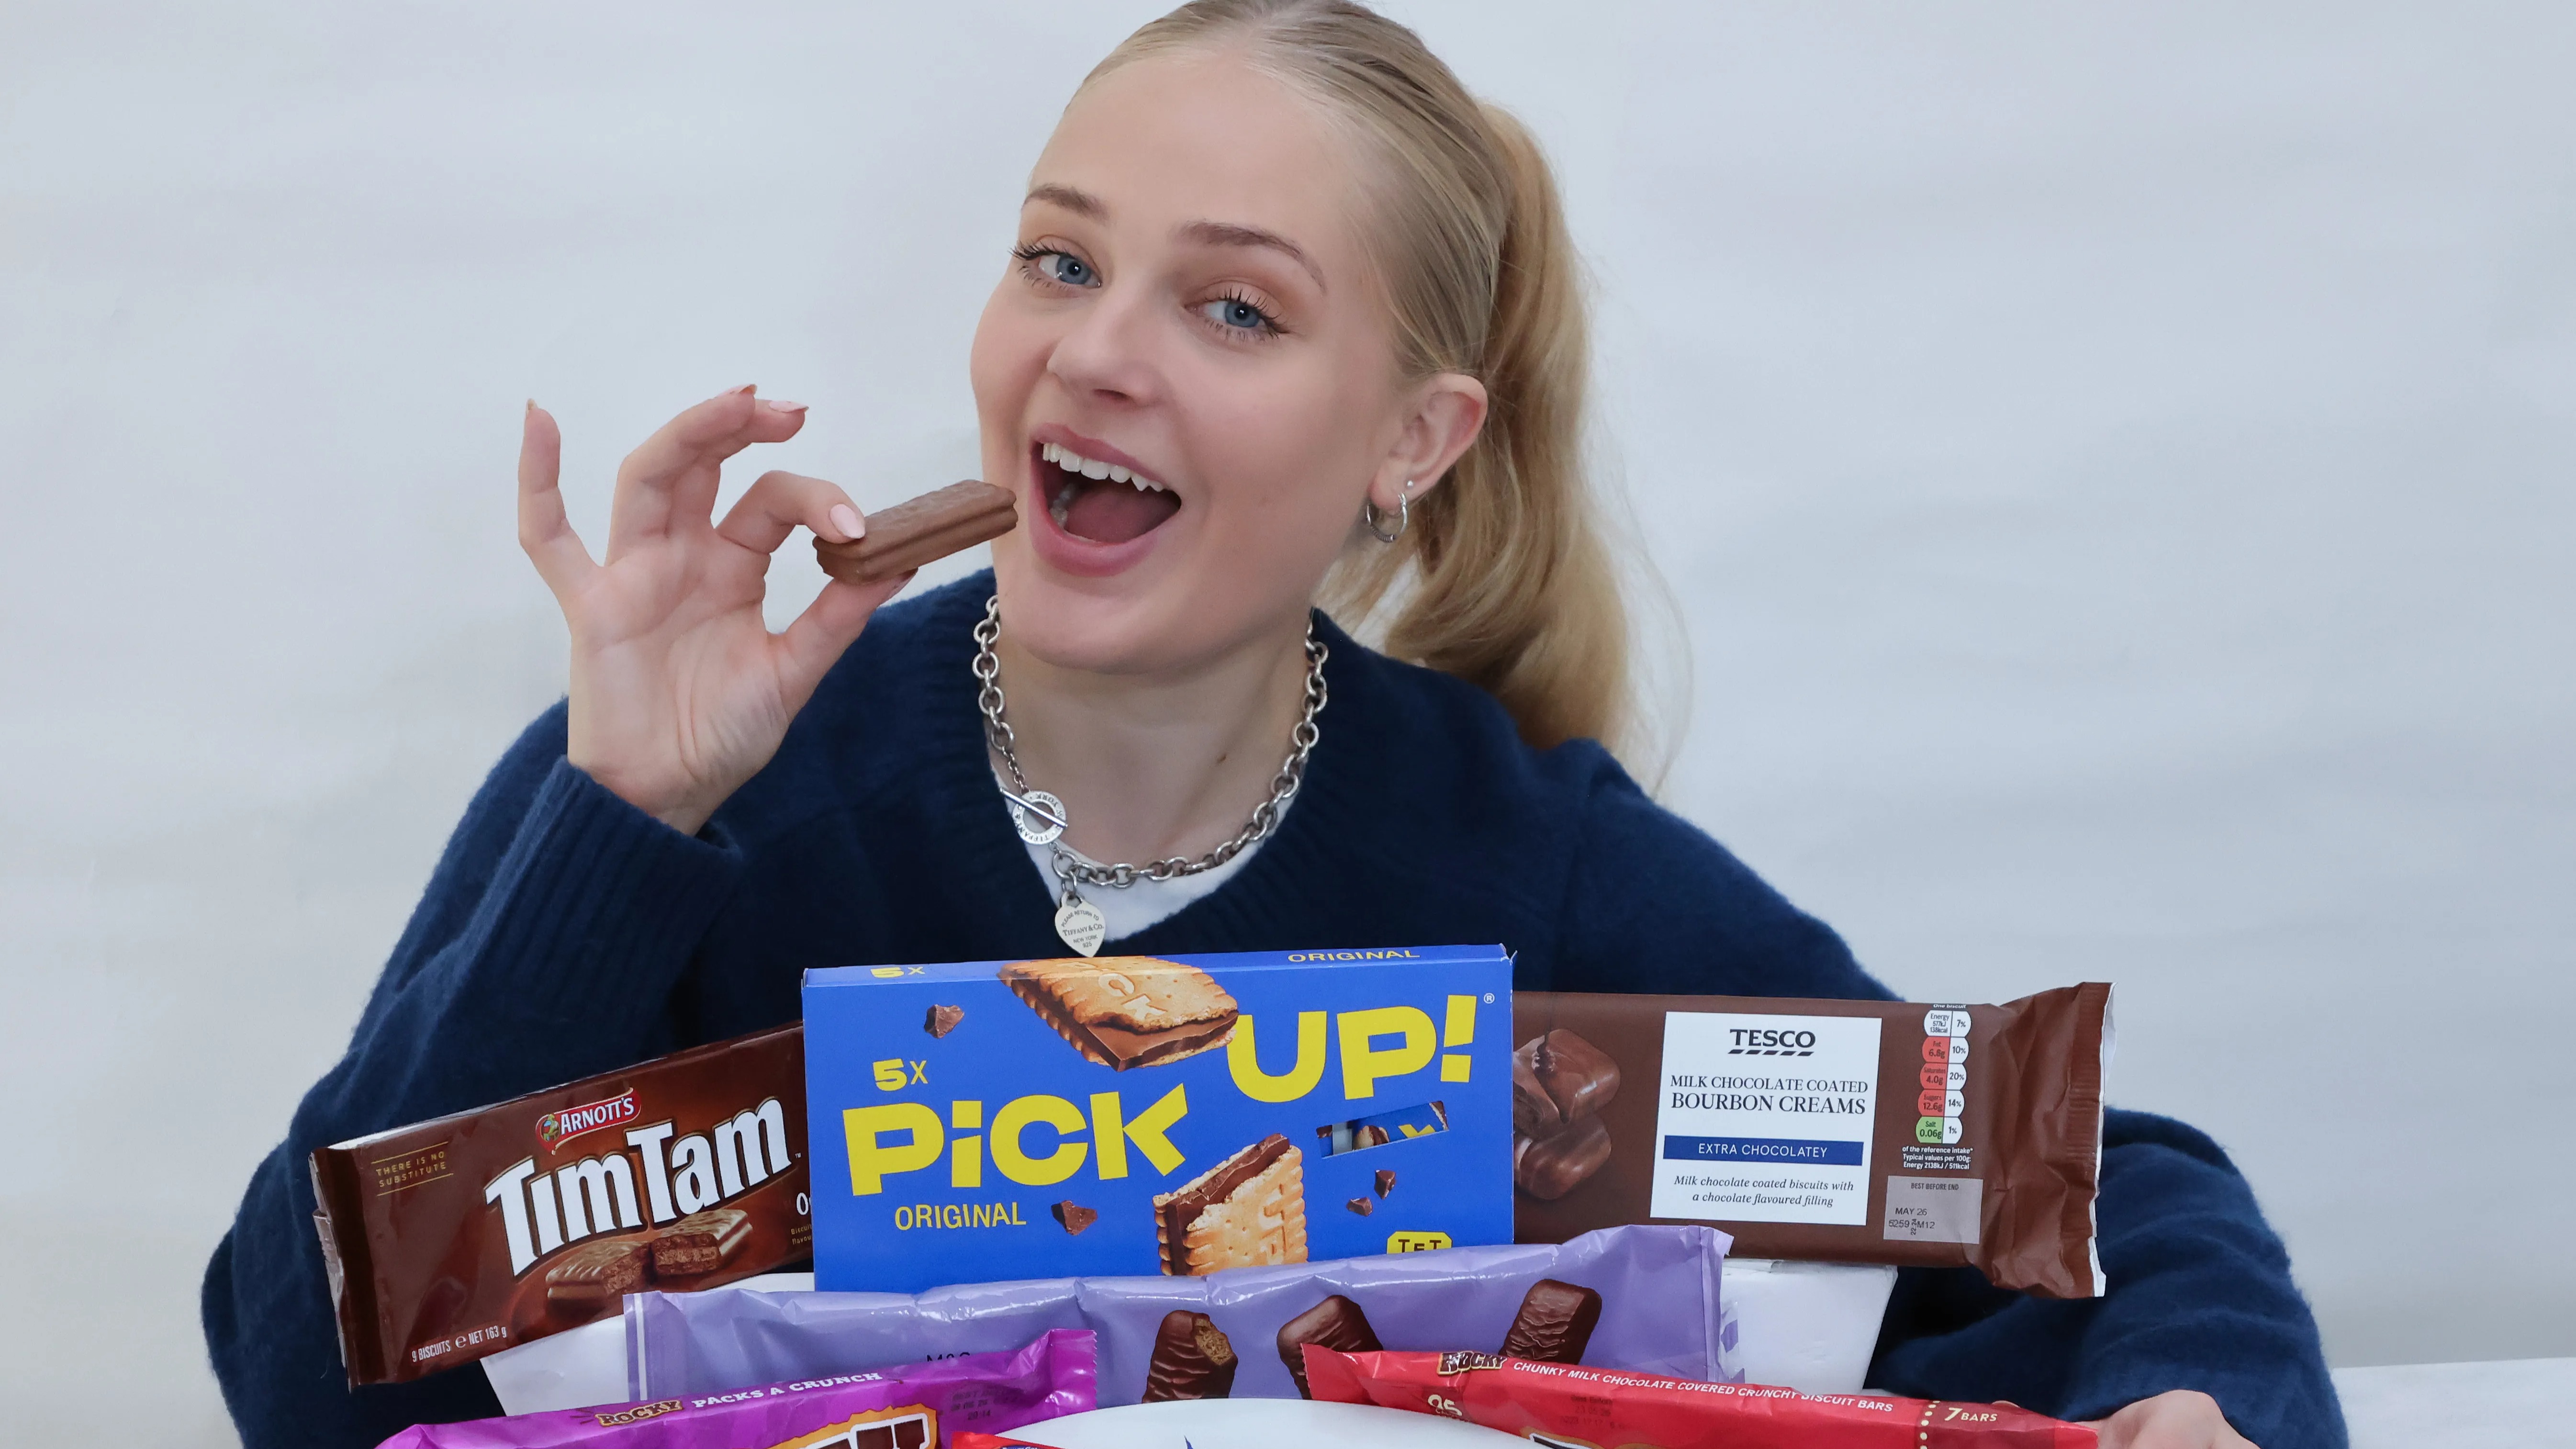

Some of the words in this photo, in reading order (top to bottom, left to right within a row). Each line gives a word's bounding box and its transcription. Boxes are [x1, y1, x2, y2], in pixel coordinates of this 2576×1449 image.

[1061, 912, 1074, 927] PLEASE
[1288, 949, 1420, 962] ORIGINAL
[1957, 1020, 1966, 1028] 7%
[1729, 1028, 1816, 1048] TESCO
[1226, 994, 1477, 1102] UP!
[1952, 1045, 1966, 1054] 10%
[1670, 1075, 1708, 1088] MILK
[1711, 1076, 1803, 1091] CHOCOLATE
[1806, 1079, 1868, 1093] COATED
[1926, 1075, 1943, 1086] 4.0g
[1949, 1072, 1964, 1080] 20%
[1671, 1092, 1774, 1111] BOURBON
[1779, 1096, 1866, 1114] CREAMS
[1923, 1102, 1943, 1112] 12.6g
[1948, 1099, 1961, 1107] 14%
[560, 1097, 634, 1135] ARNOTT'S
[1920, 1129, 1942, 1140] 0.06g
[1949, 1126, 1957, 1134] 1%
[1698, 1143, 1737, 1155] EXTRA
[1742, 1144, 1828, 1158] CHOCOLATEY
[376, 1160, 412, 1176] THERE
[416, 1157, 426, 1165] IS
[431, 1151, 445, 1160] NO
[379, 1162, 447, 1187] SUBSTITUTE
[1674, 1175, 1698, 1186] Milk
[1700, 1177, 1750, 1188] chocolate
[1752, 1179, 1786, 1189] coated
[1789, 1179, 1828, 1191] biscuits
[1831, 1181, 1854, 1191] with
[1702, 1192, 1751, 1203] chocolate
[1752, 1193, 1802, 1205] flavoured
[1803, 1194, 1834, 1208] filling
[895, 1202, 1027, 1231] ORIGINAL
[1889, 1219, 1910, 1228] 5259
[412, 1350, 417, 1362] 9
[418, 1340, 451, 1361] BISCUITS
[468, 1329, 482, 1345] NET
[485, 1325, 500, 1340] 163
[501, 1326, 507, 1338] g
[1513, 1362, 1566, 1376] CHUNKY
[1568, 1370, 1601, 1382] MILK
[1602, 1375, 1676, 1389] CHOCOLATE
[1677, 1382, 1735, 1395] COVERED
[1737, 1388, 1797, 1399] CRUNCHY
[1858, 1400, 1893, 1412] BARS
[594, 1400, 683, 1427] ROCKY
[691, 1390, 764, 1409] PACKS
[770, 1387, 785, 1396] A
[788, 1372, 883, 1392] CRUNCH
